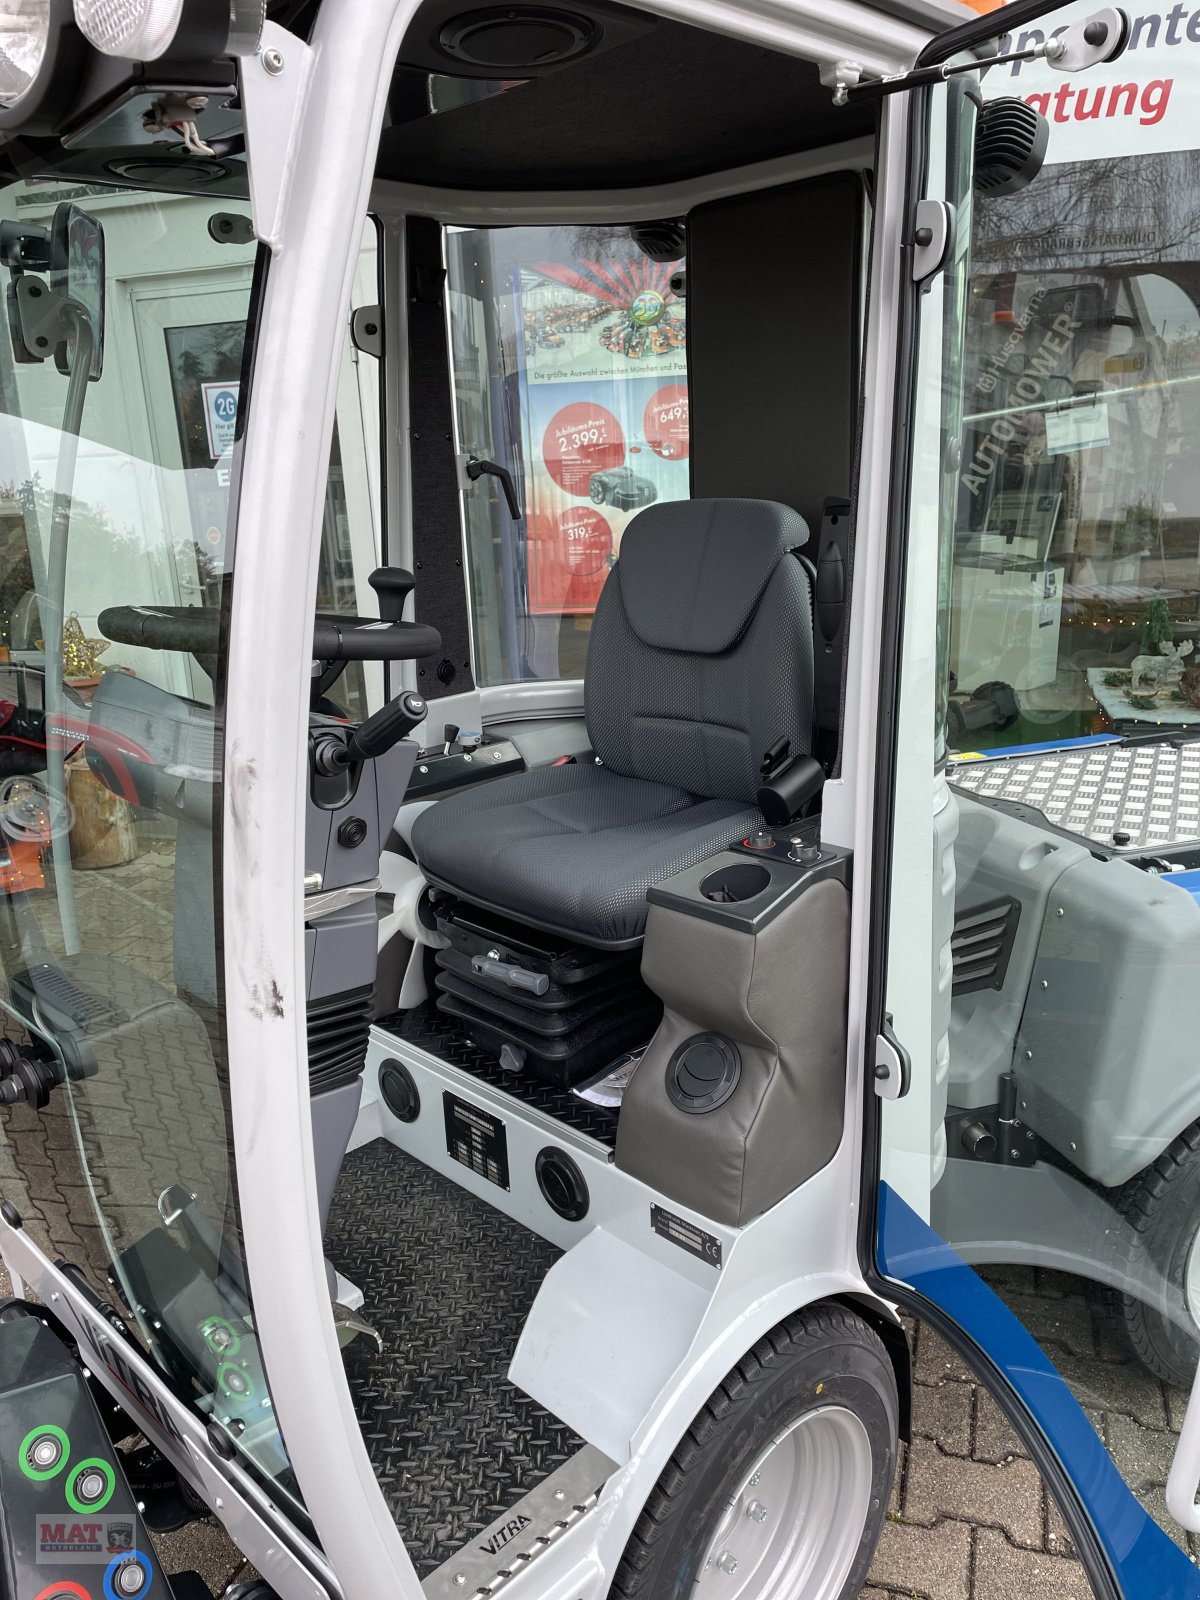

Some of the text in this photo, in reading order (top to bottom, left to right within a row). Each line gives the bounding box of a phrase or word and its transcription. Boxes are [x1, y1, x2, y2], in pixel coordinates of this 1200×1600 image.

[987, 286, 1048, 376] Husqvarna
[534, 363, 687, 381] Die größte Auswahl zwischen München und Pas
[217, 397, 235, 416] 2G
[478, 1514, 533, 1556] VITRA
